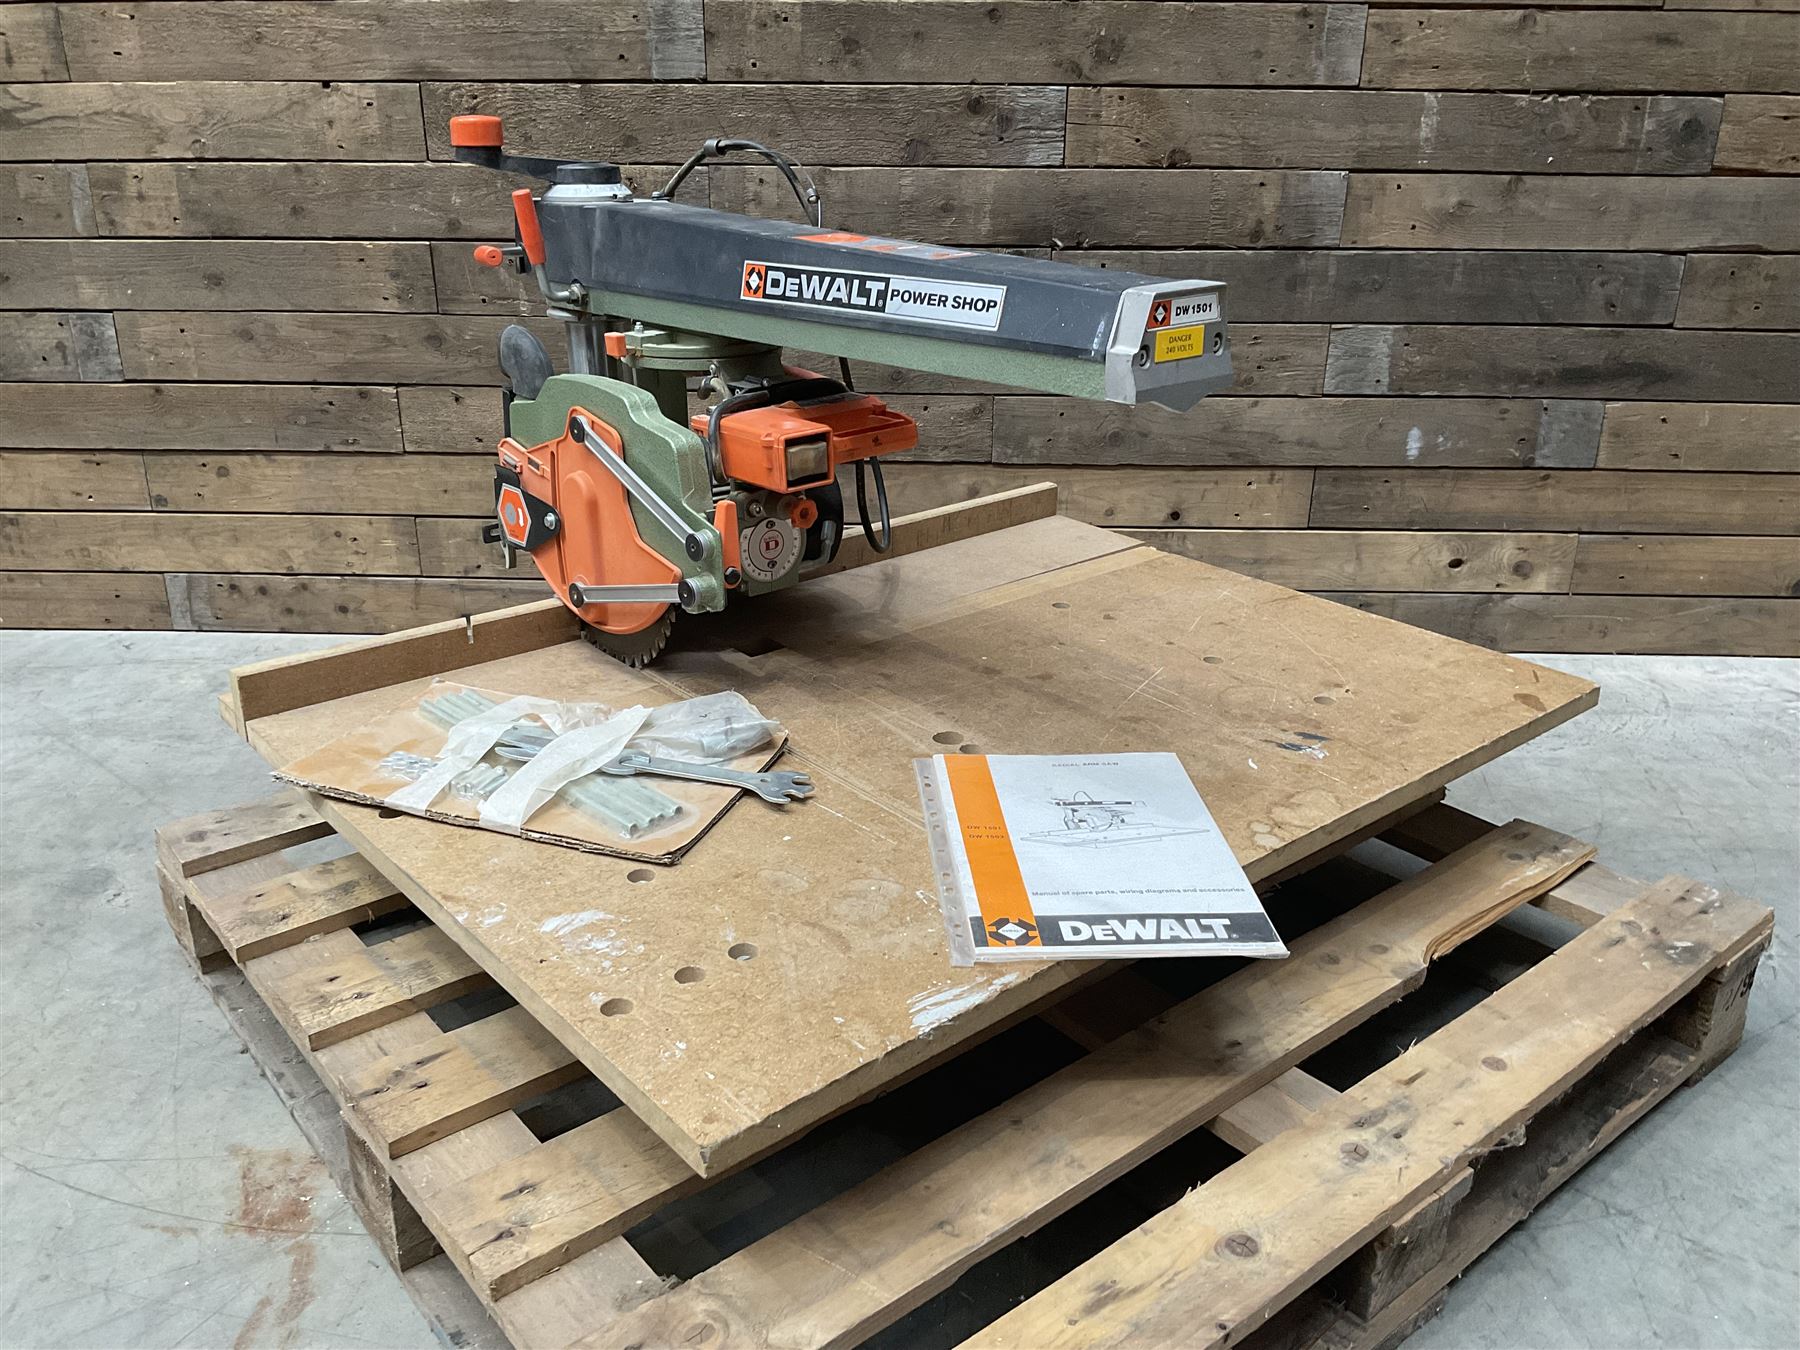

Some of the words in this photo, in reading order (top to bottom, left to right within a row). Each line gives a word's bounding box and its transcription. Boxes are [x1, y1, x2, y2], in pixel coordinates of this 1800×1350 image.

[890, 289, 948, 308] POWER
[951, 295, 998, 312] SHOP
[1175, 304, 1190, 316] DW
[1191, 303, 1212, 314] 1501
[1168, 334, 1192, 344] DANGER
[1176, 343, 1194, 352] VOLTS
